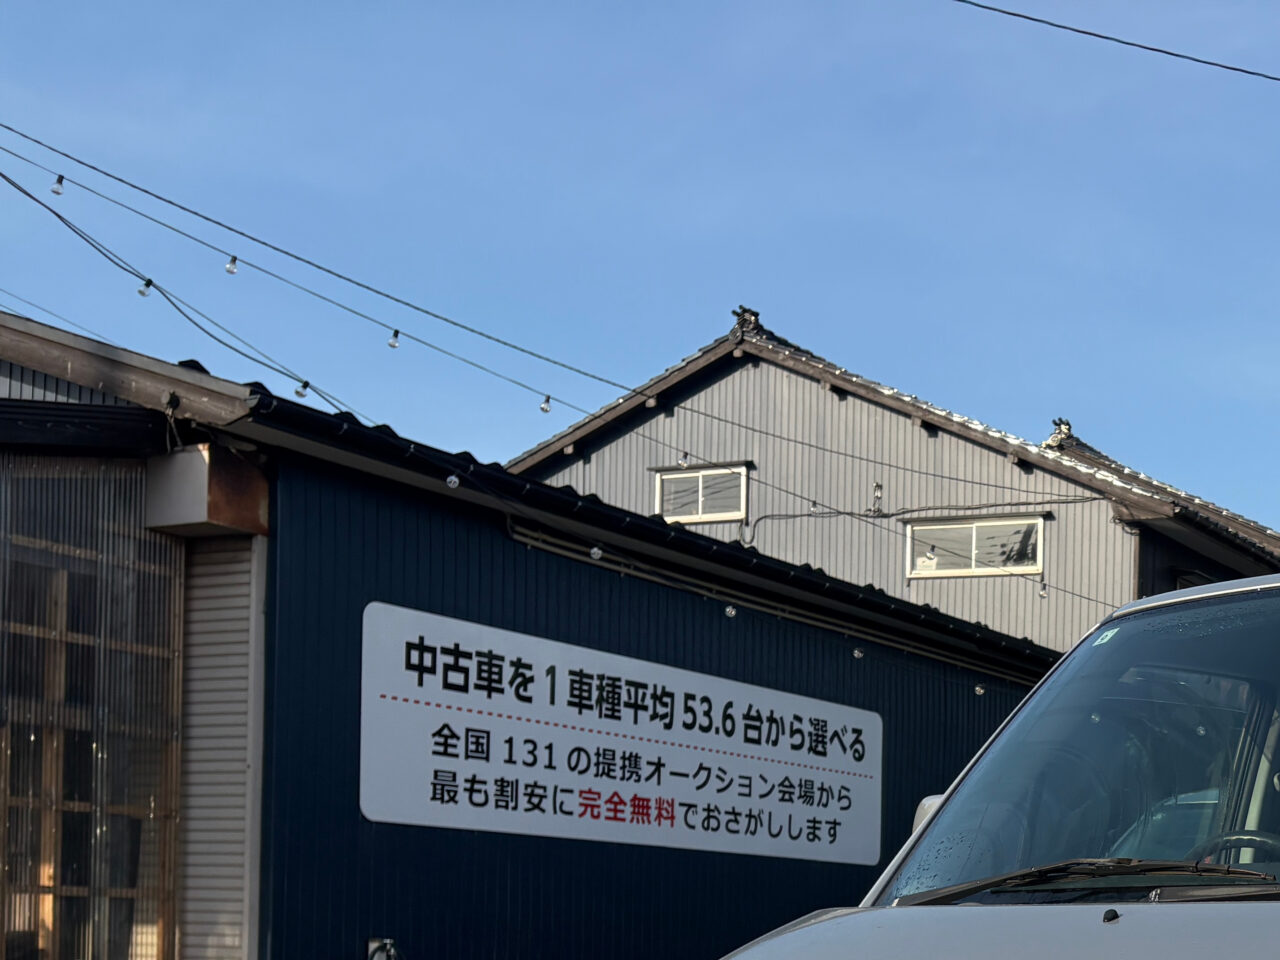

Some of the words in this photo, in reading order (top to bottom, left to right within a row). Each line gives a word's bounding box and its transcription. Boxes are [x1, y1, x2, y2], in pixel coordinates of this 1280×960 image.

[430, 770, 842, 846] 最も割安に完全無料でおさがしします
